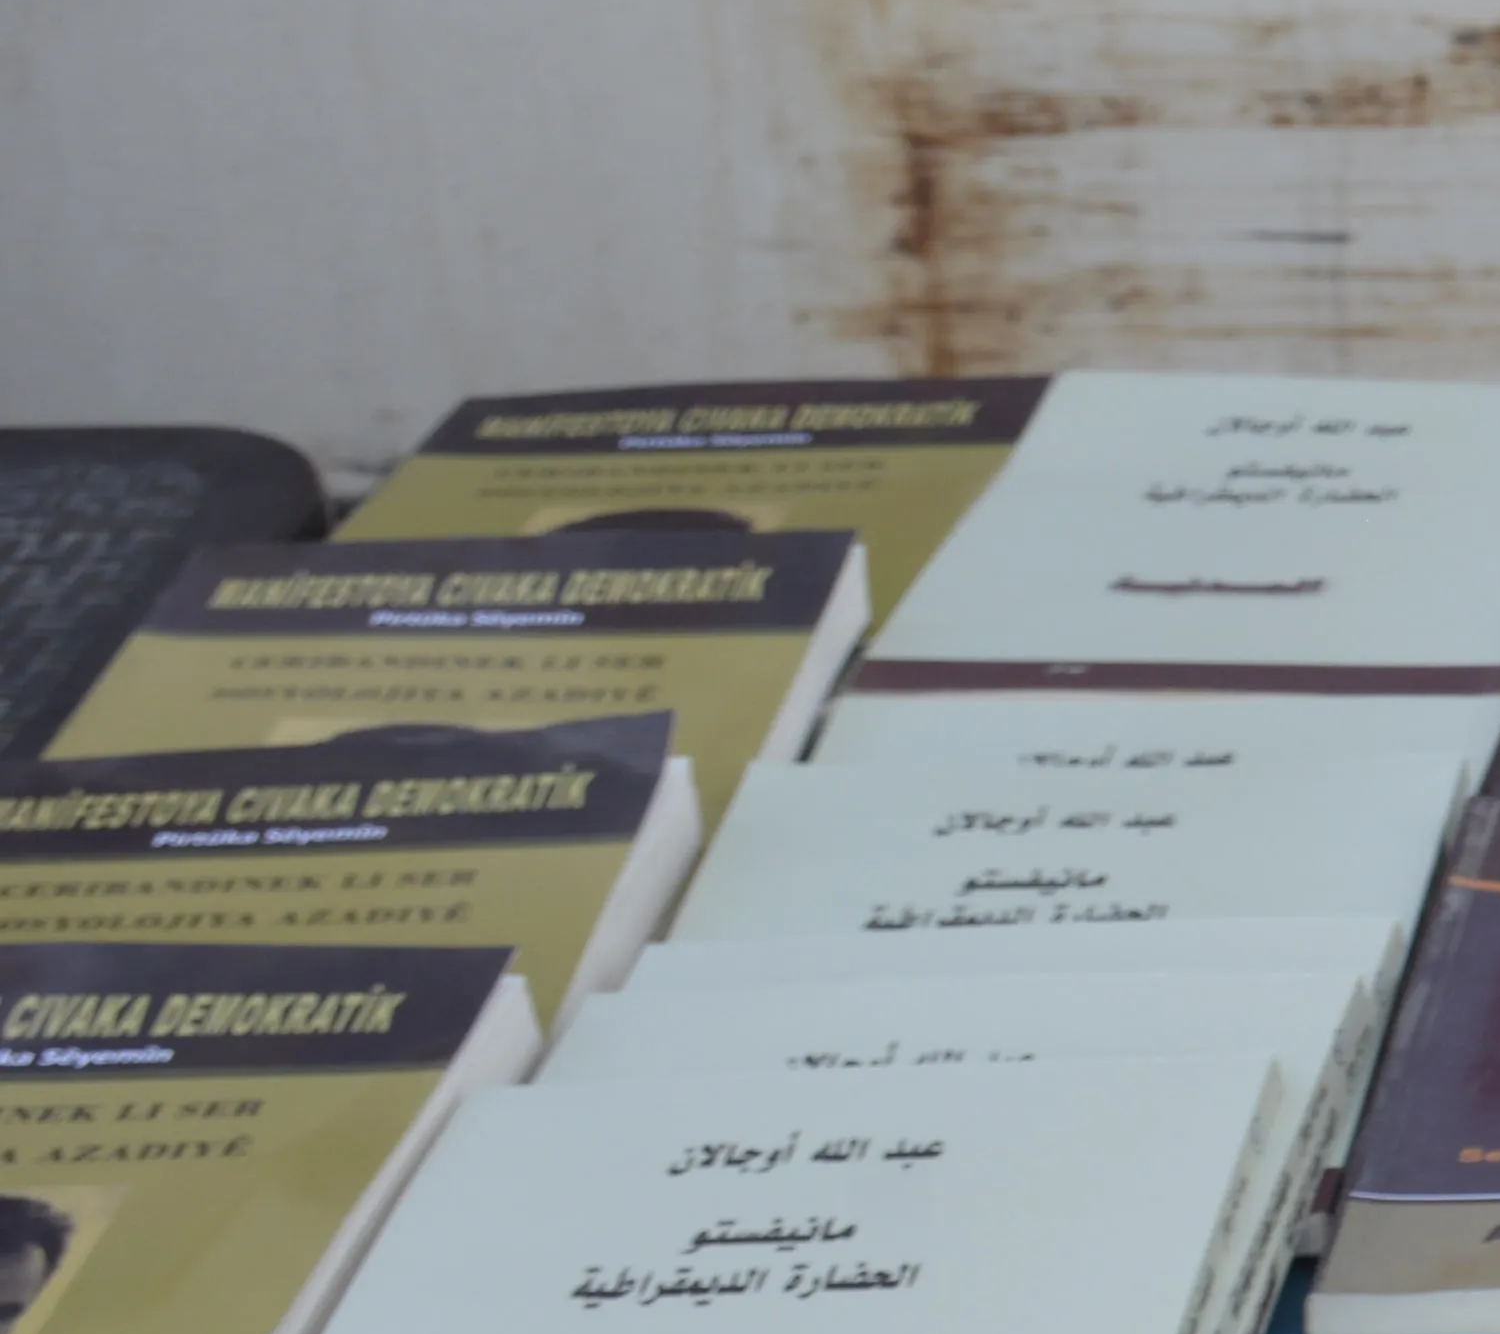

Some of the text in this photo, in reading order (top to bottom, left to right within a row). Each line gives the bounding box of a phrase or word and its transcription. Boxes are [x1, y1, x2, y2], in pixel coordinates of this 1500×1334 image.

[226, 781, 361, 825] CIVAKA
[3, 983, 406, 1040] CIVAKA DEMOKRATÎK
[665, 1131, 946, 1178] عبد الله أوجالان
[681, 1216, 859, 1256] مانيفستو
[569, 1263, 923, 1310] الحضارة الديمقراطية
